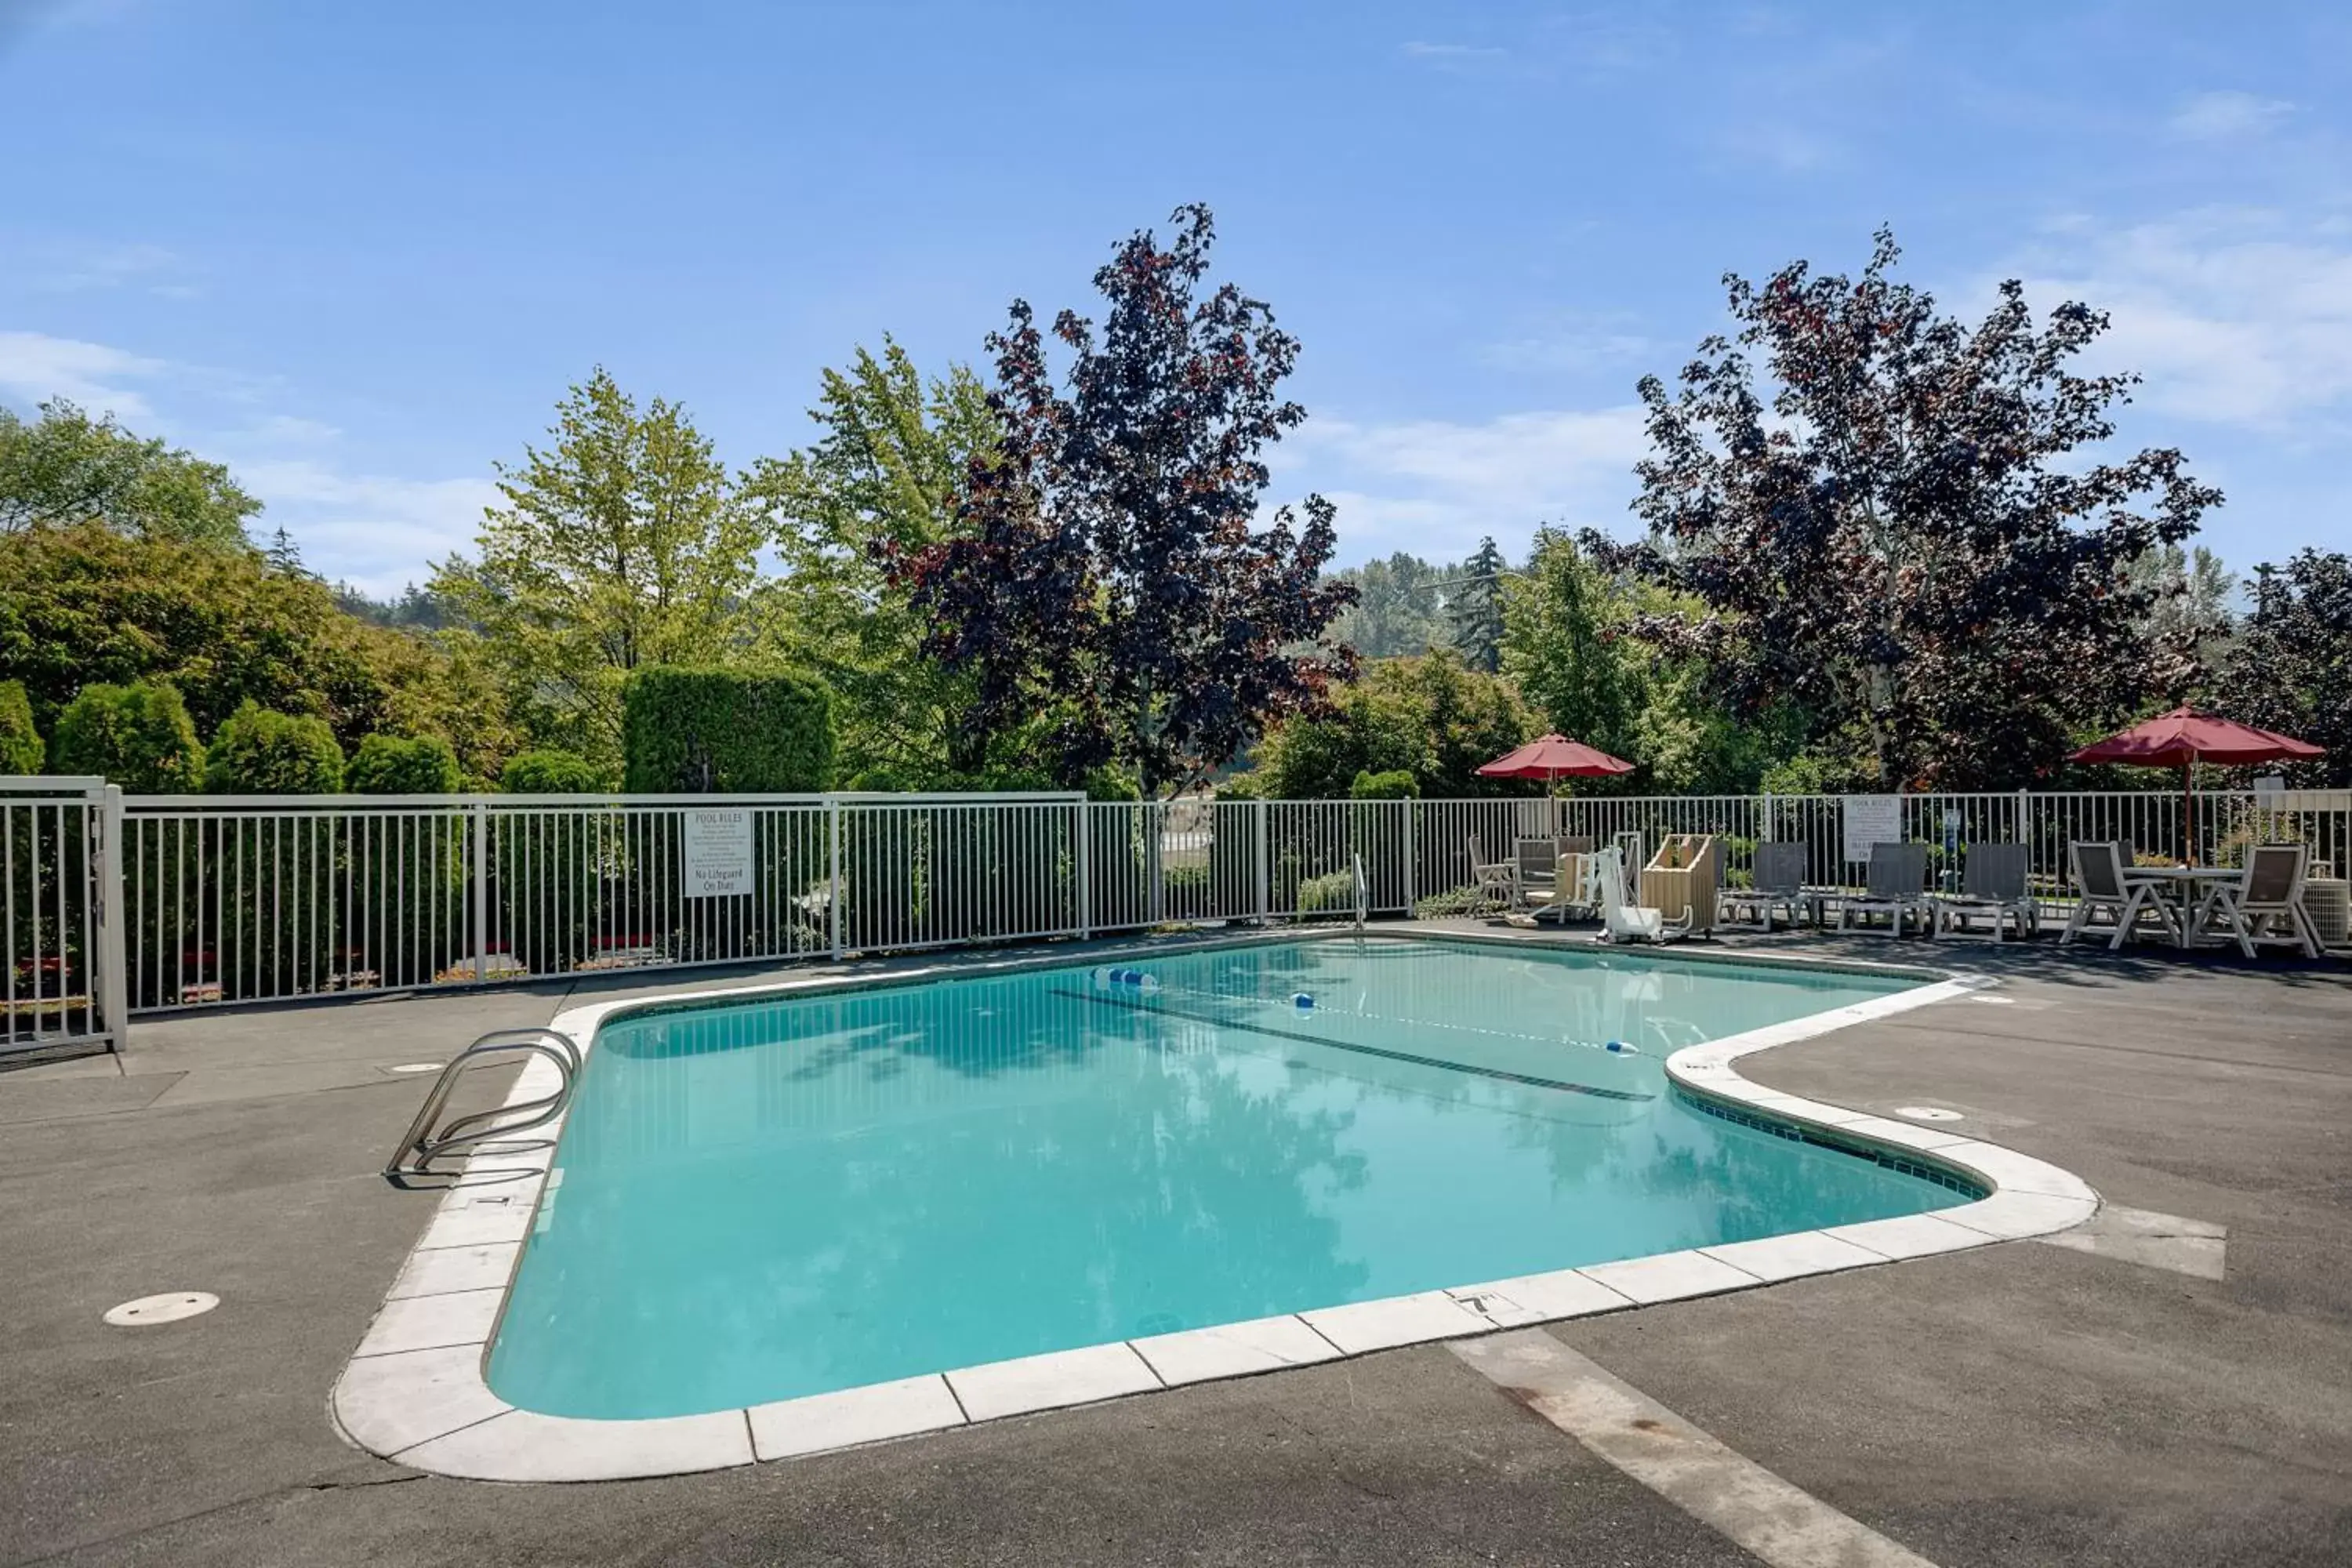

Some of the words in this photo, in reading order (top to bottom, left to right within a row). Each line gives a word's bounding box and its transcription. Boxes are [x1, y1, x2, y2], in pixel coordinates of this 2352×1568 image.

[695, 813, 717, 823] POOL
[719, 813, 742, 822] RULES
[695, 869, 706, 879] No
[708, 868, 742, 880] Lifeguard
[703, 880, 716, 891] On
